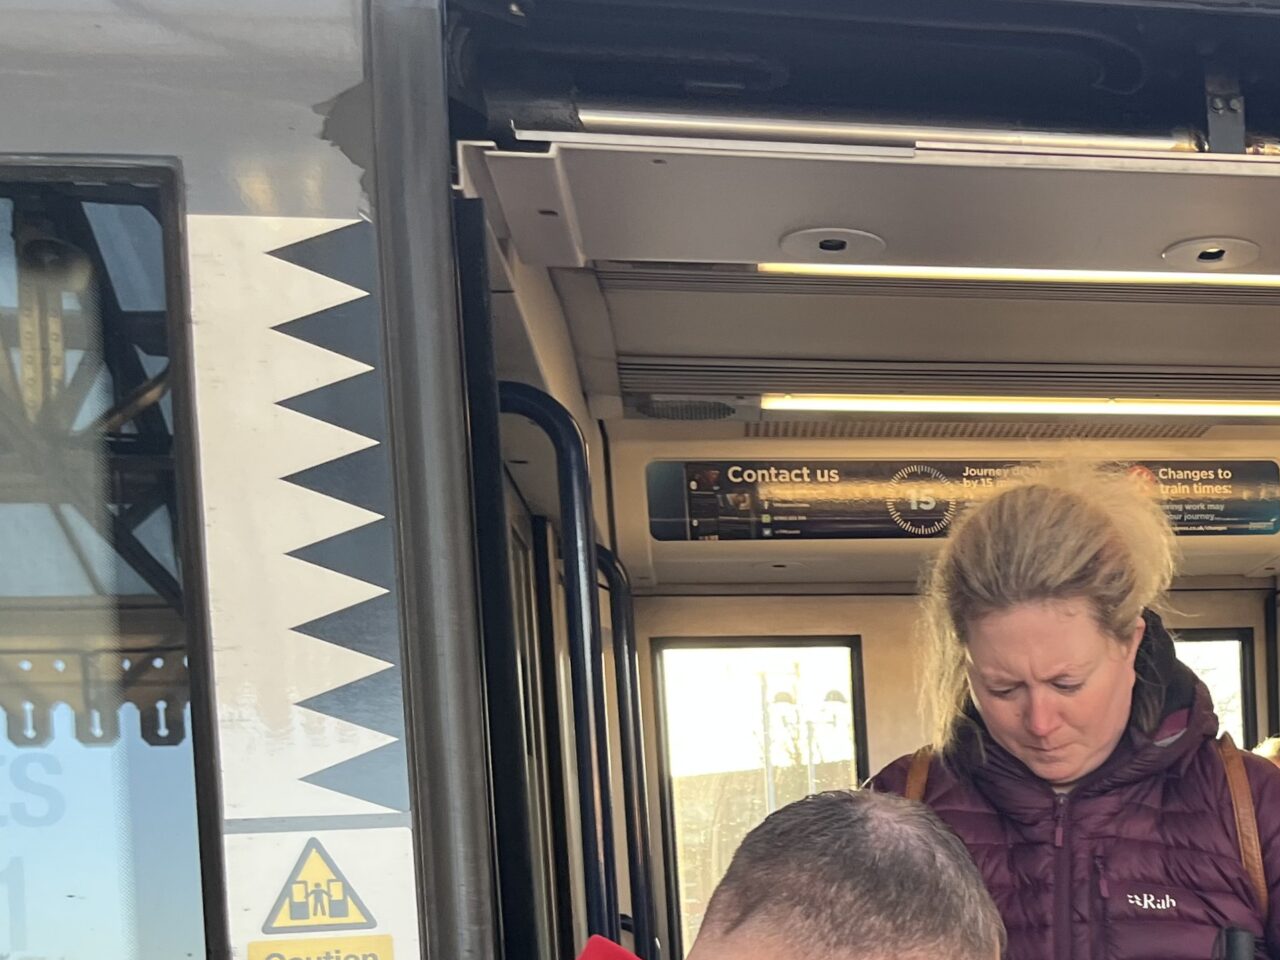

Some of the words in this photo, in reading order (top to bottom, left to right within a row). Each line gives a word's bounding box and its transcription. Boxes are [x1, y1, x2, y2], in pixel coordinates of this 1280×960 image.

[727, 466, 811, 483] Contact
[816, 468, 840, 482] us
[962, 466, 1009, 480] Journey
[1158, 468, 1215, 481] Changes
[1218, 469, 1232, 479] to
[962, 478, 978, 489] by
[980, 478, 993, 488] 15
[1160, 482, 1190, 495] train
[1193, 482, 1232, 495] times:
[908, 488, 936, 510] 15
